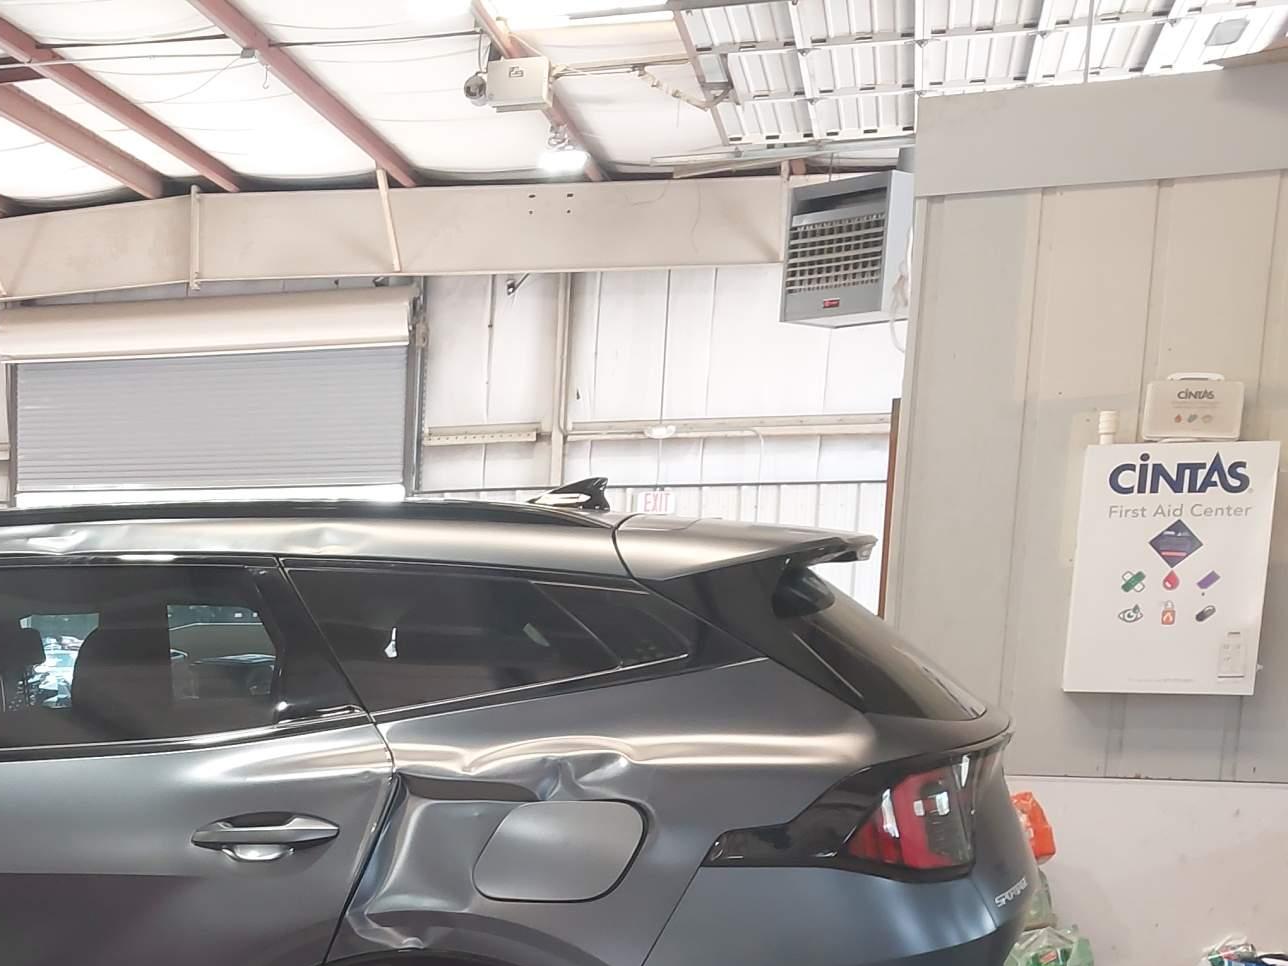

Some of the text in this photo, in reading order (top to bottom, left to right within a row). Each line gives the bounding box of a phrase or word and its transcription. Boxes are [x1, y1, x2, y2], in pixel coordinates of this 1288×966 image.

[643, 492, 671, 512] EXIT
[1108, 503, 1252, 519] First Aid Center
